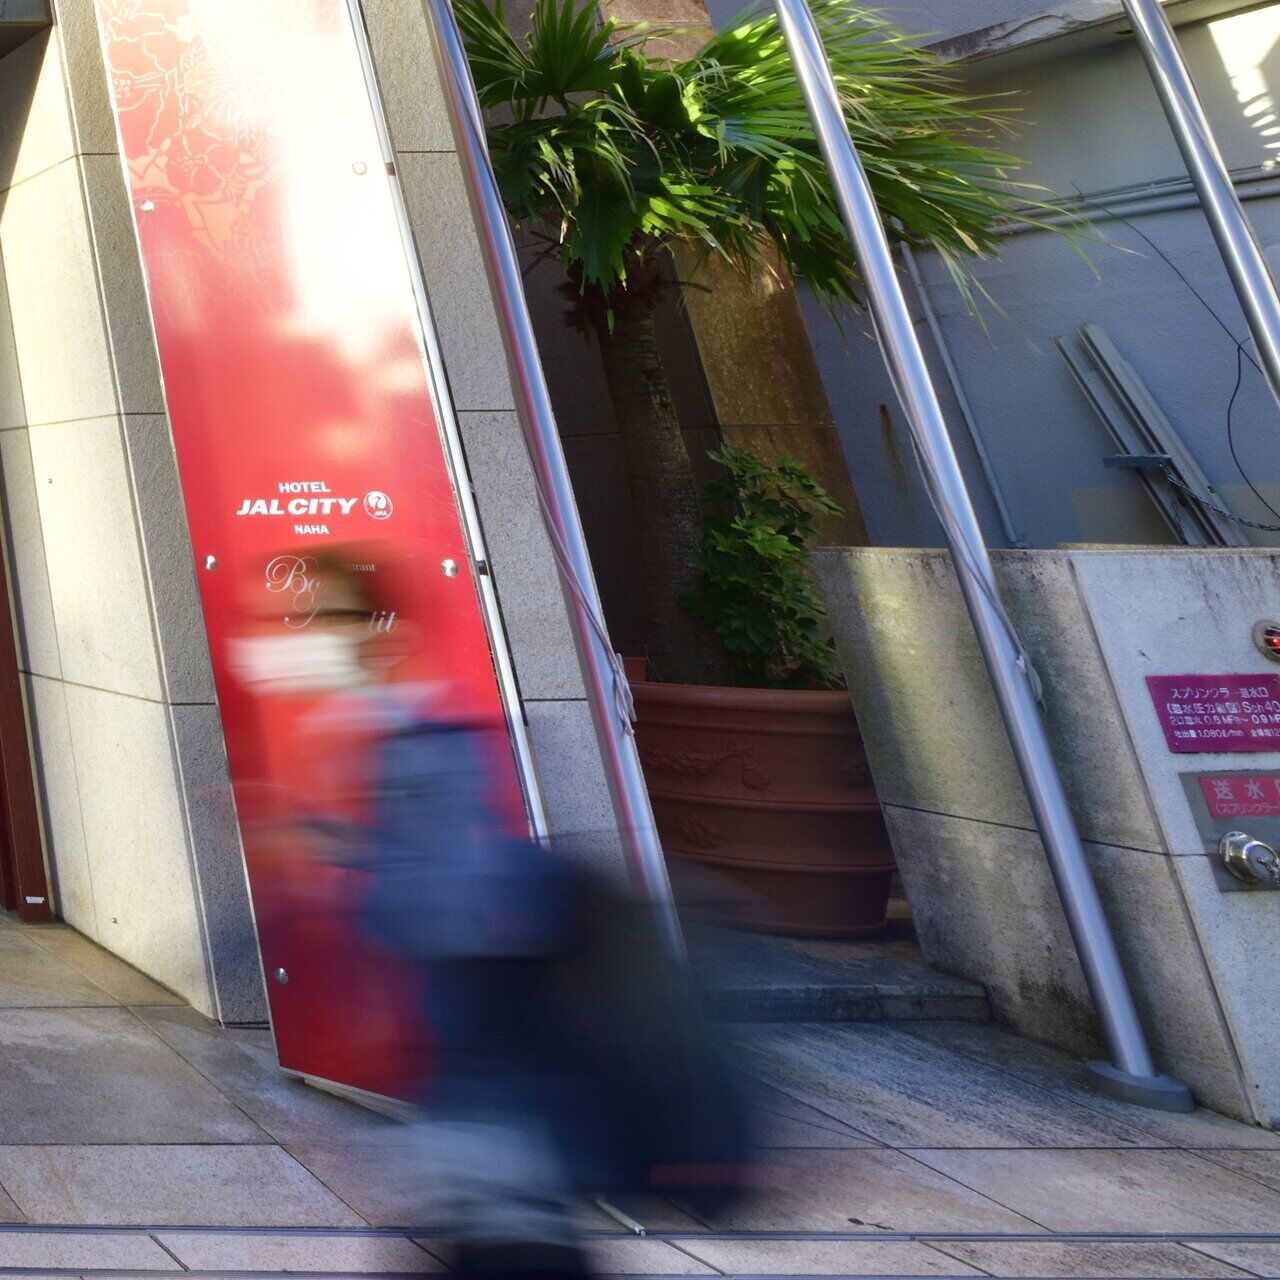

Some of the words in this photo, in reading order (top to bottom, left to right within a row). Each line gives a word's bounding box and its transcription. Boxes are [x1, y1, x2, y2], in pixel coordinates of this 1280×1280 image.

[278, 481, 331, 493] HOTEL
[236, 499, 285, 516] JAL
[287, 497, 358, 515] CITY
[294, 524, 330, 535] NAHA
[1211, 778, 1280, 800] 送水
